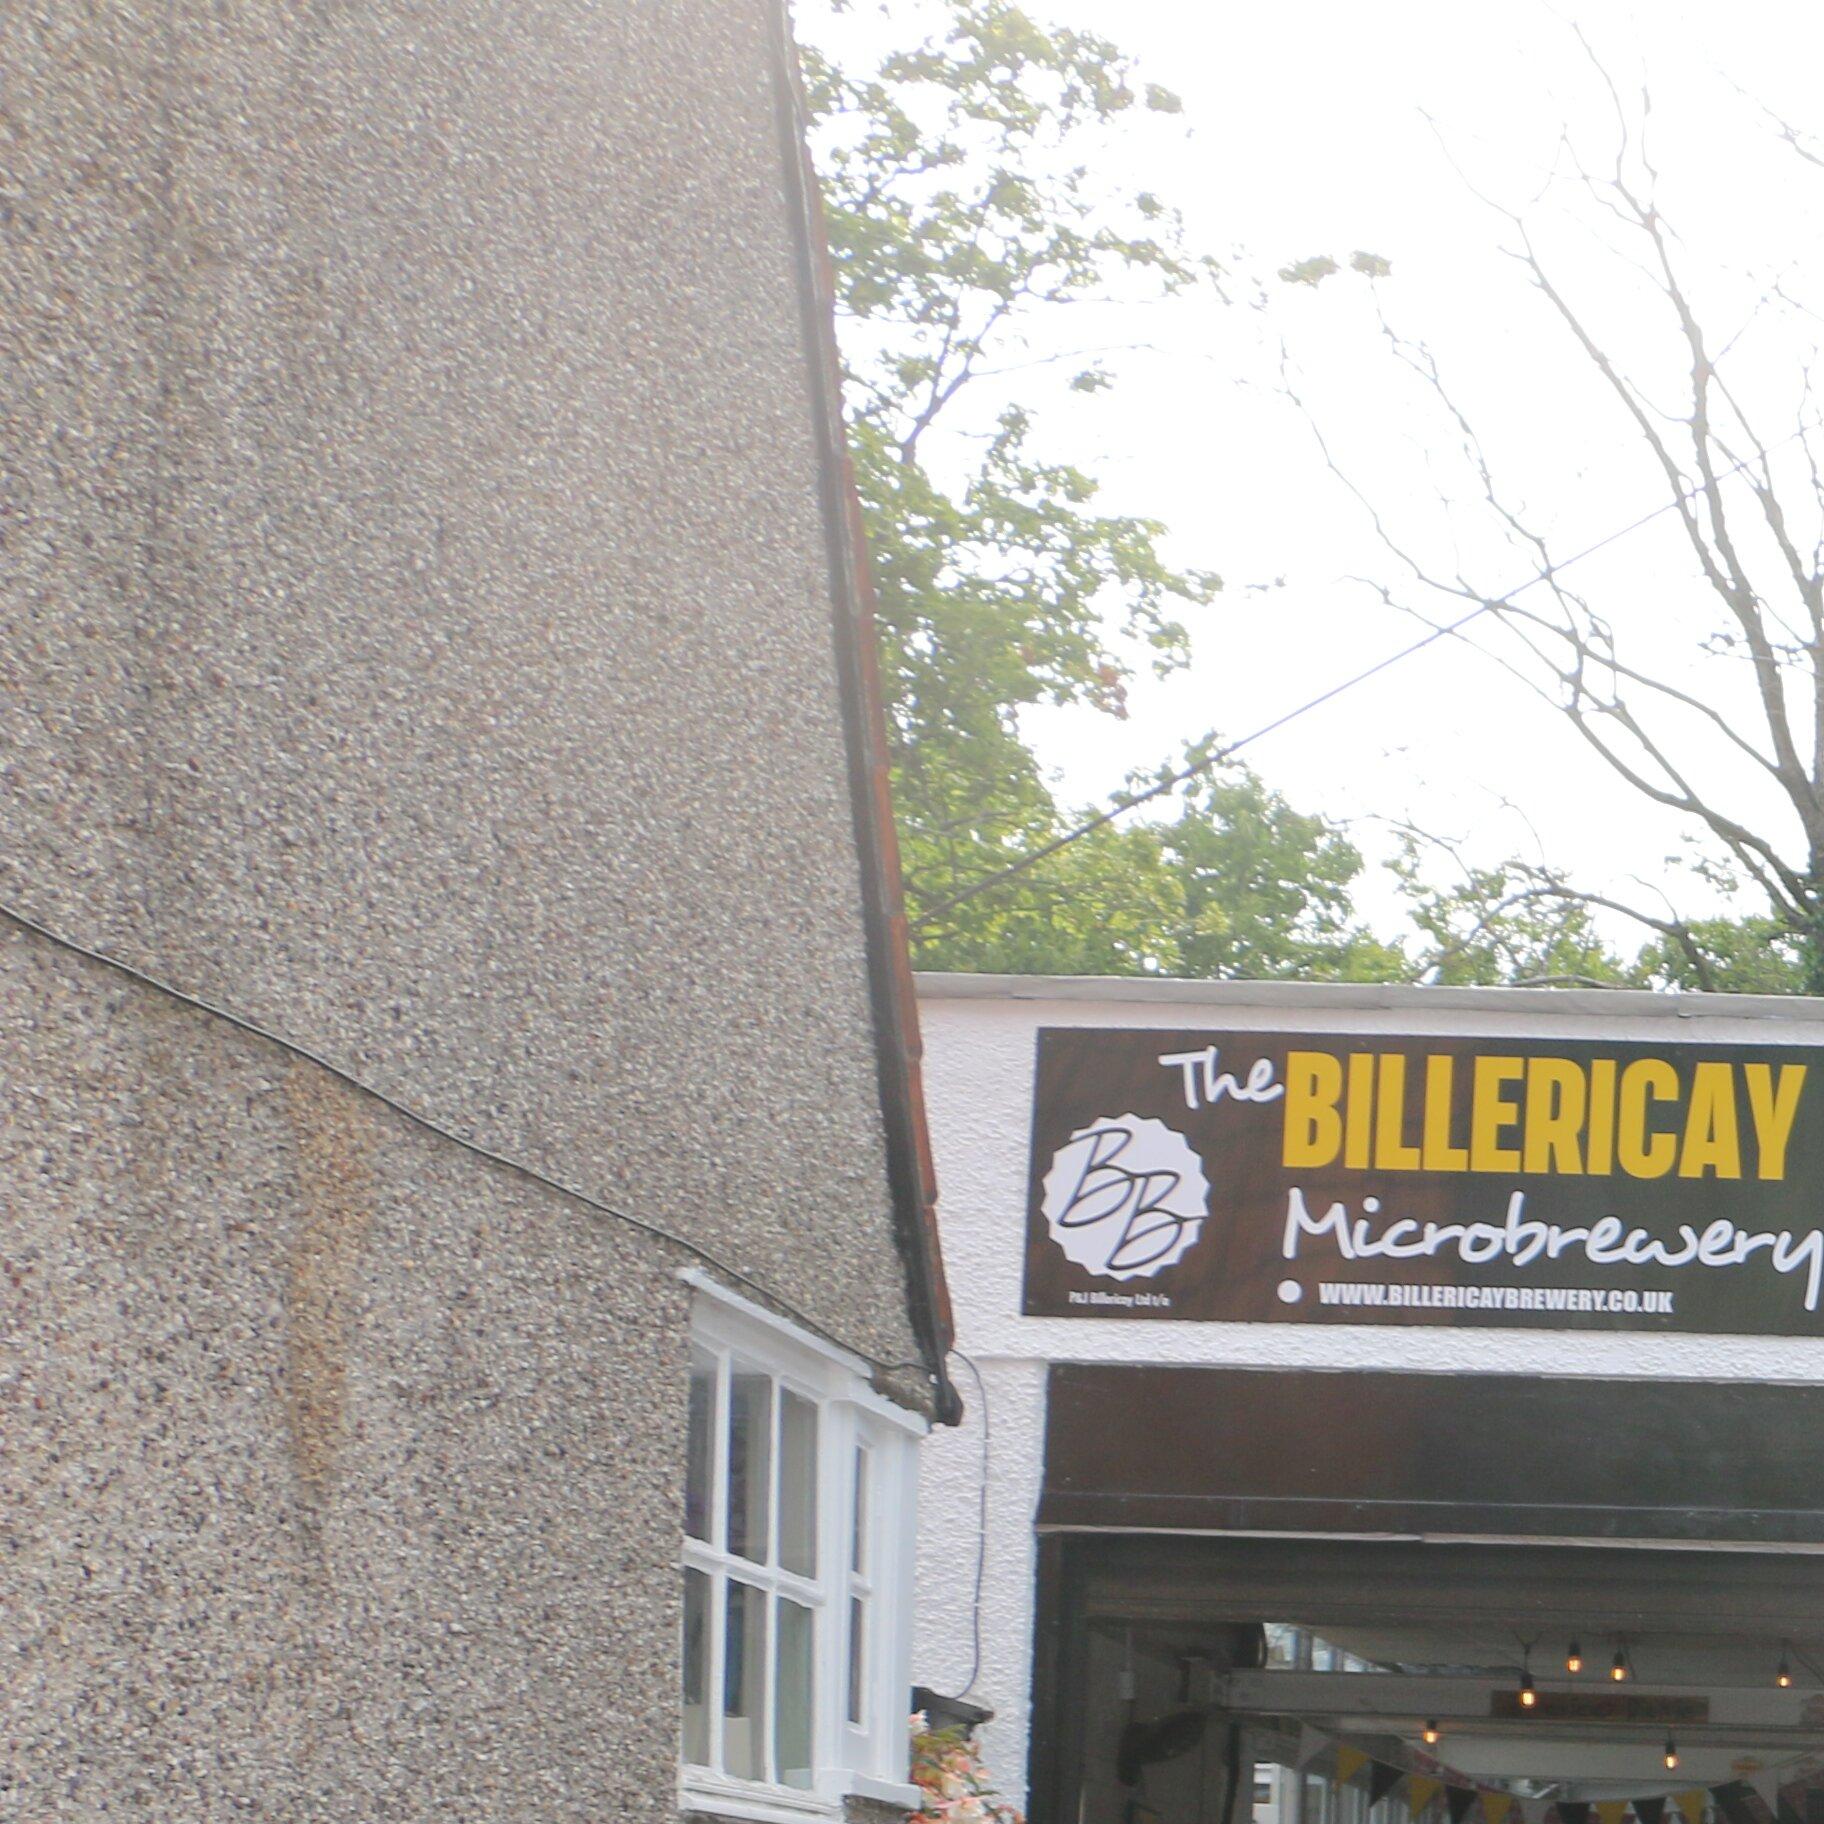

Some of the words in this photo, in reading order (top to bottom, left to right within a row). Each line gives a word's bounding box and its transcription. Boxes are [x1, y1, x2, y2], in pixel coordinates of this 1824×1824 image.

[1158, 1045, 1284, 1108] The
[1283, 1050, 1806, 1181] BILLERICAY
[1282, 1186, 1823, 1311] Microbrewery
[1319, 1281, 1674, 1314] WWW.BILLERICAYBREWERY.CO.UK
